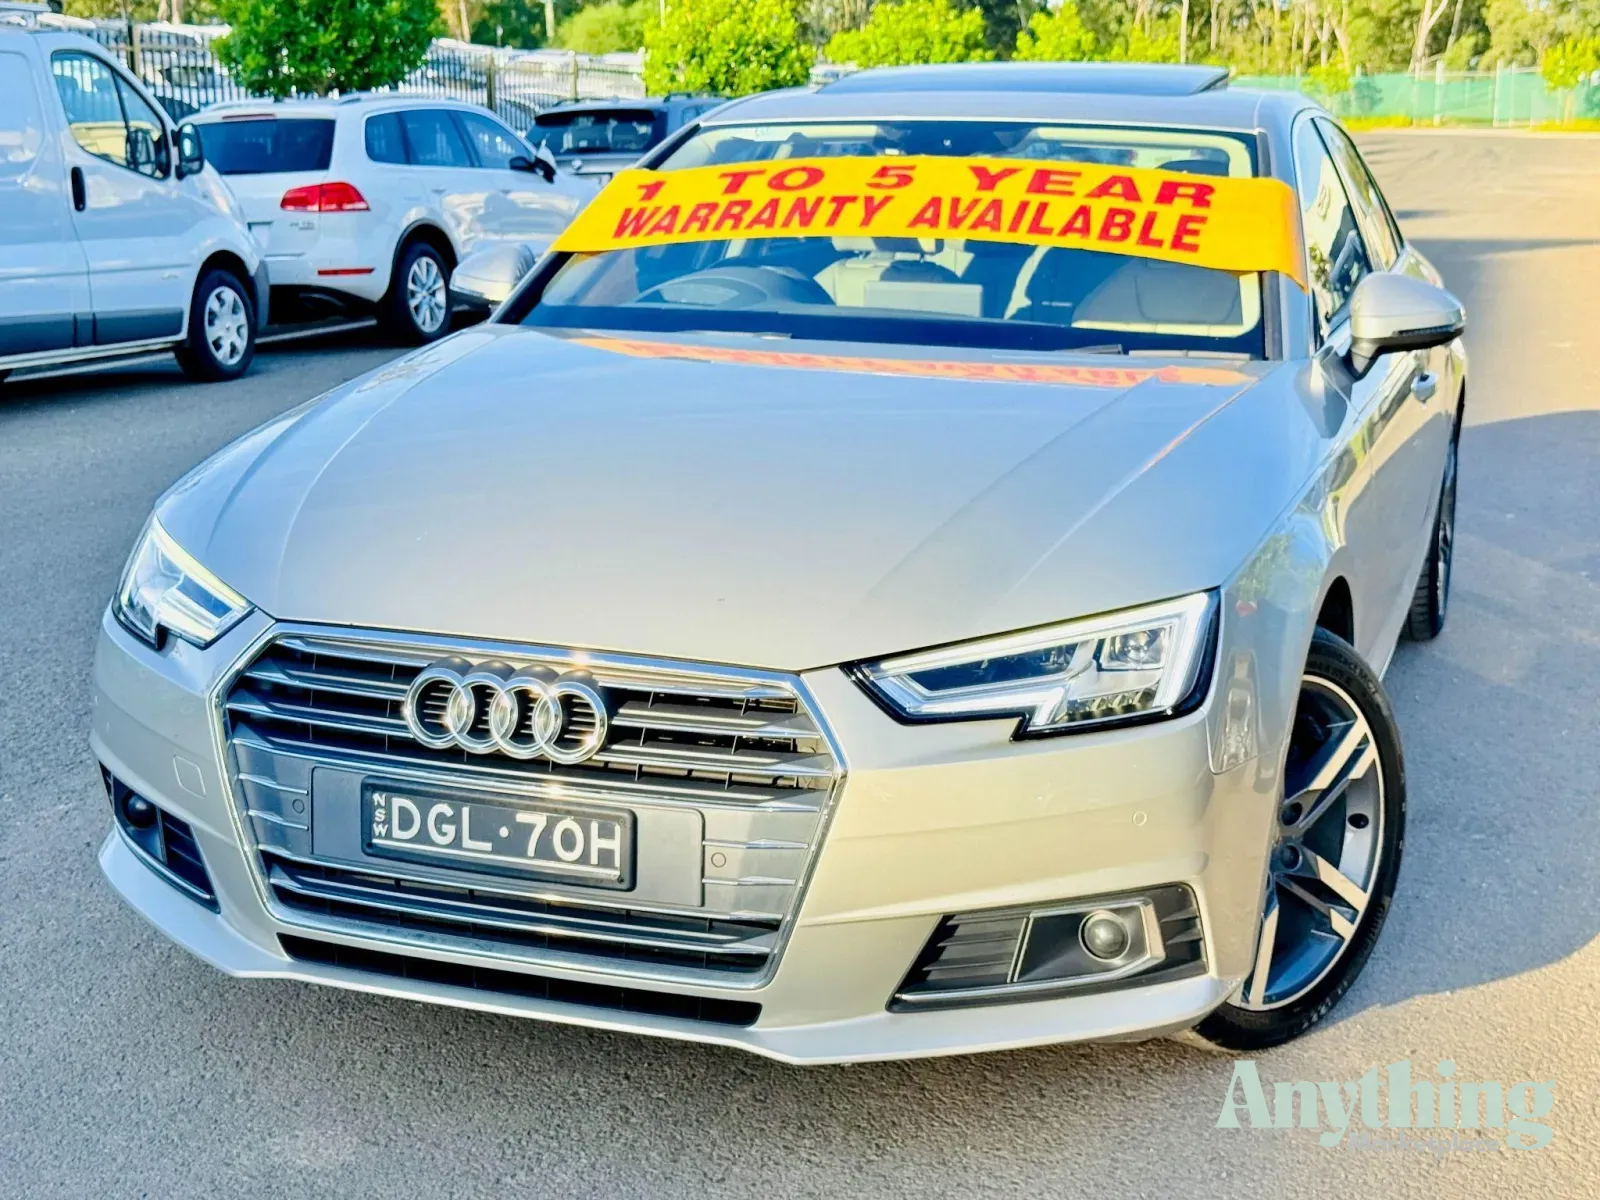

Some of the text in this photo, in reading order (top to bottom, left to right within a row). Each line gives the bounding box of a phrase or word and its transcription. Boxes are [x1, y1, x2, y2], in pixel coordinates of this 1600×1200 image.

[636, 165, 1216, 209] 1 TO 5 YEAR
[613, 195, 1209, 253] WARRANTY AVAILABLE
[372, 792, 388, 838] NSW
